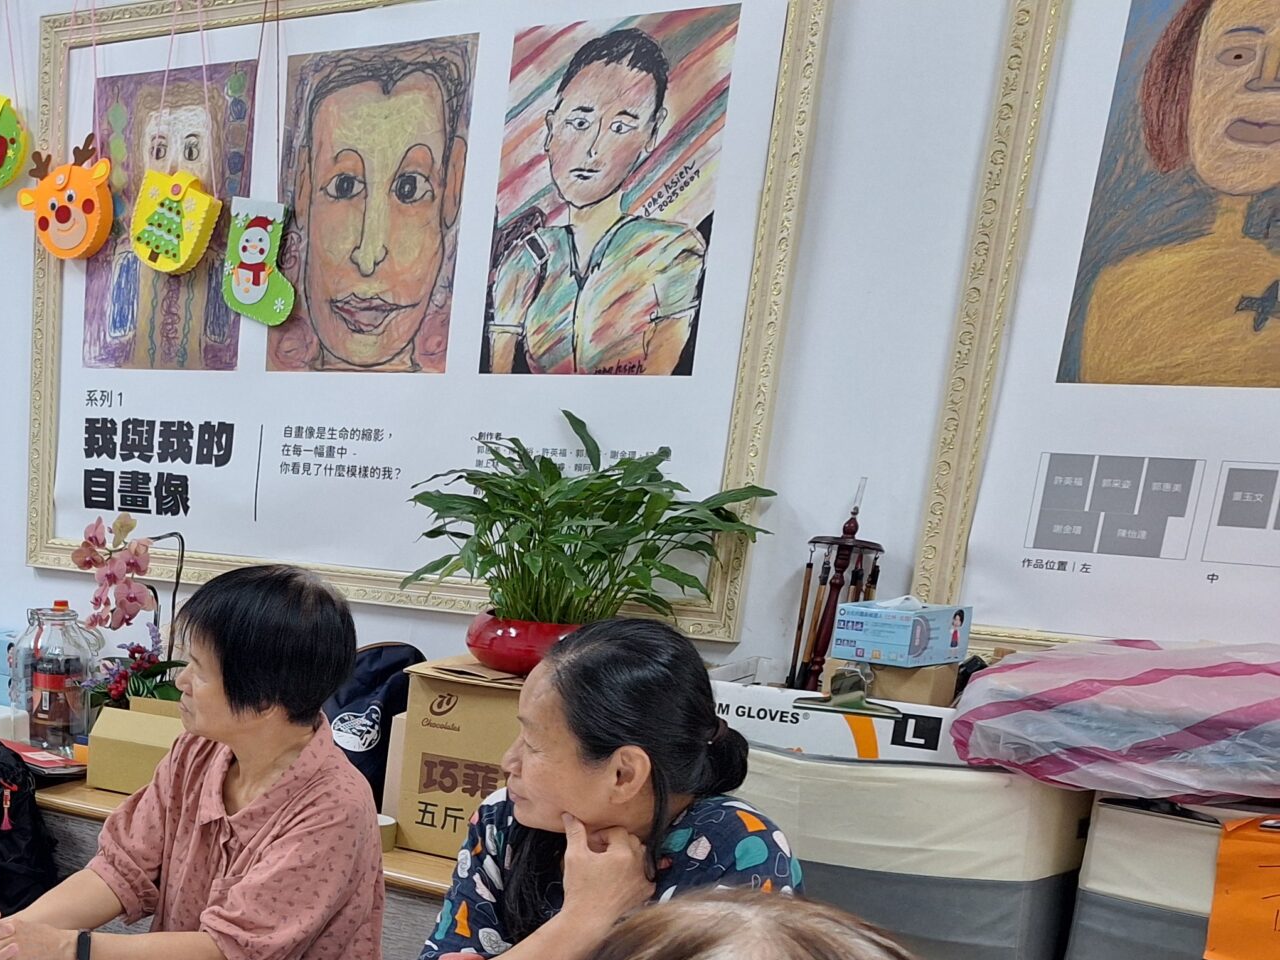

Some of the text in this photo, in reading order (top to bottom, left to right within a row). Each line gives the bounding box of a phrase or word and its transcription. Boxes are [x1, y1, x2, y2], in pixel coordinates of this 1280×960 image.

[85, 389, 113, 407] 系列
[83, 417, 235, 468] 我與我的
[83, 468, 191, 517] 自畫像
[1206, 572, 1220, 585] 中
[735, 705, 801, 725] GLOVES
[904, 718, 926, 745] L
[423, 759, 510, 799] 巧菲
[415, 800, 466, 834] 五斤
